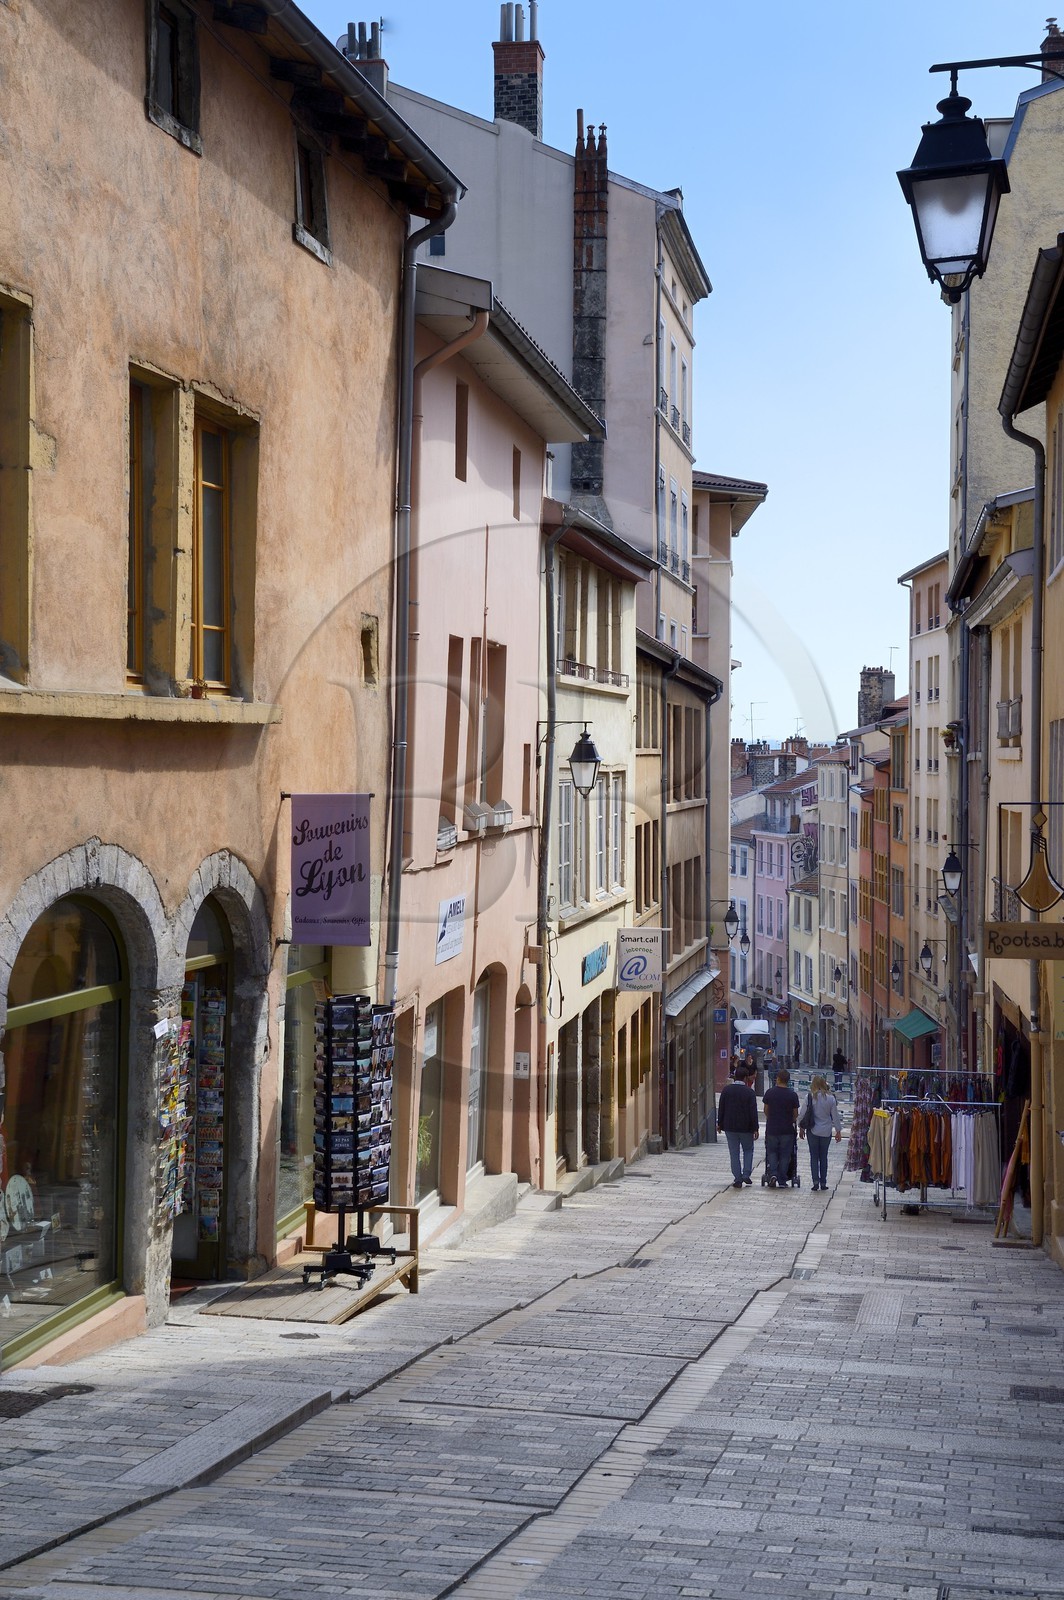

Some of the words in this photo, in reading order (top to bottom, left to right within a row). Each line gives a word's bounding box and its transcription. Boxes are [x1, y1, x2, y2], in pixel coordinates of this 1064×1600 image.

[292, 813, 369, 846] Souvenirs
[322, 839, 344, 864] de
[295, 857, 367, 901] Lyon
[448, 899, 465, 918] AMELY
[620, 934, 659, 943] Smart.call
